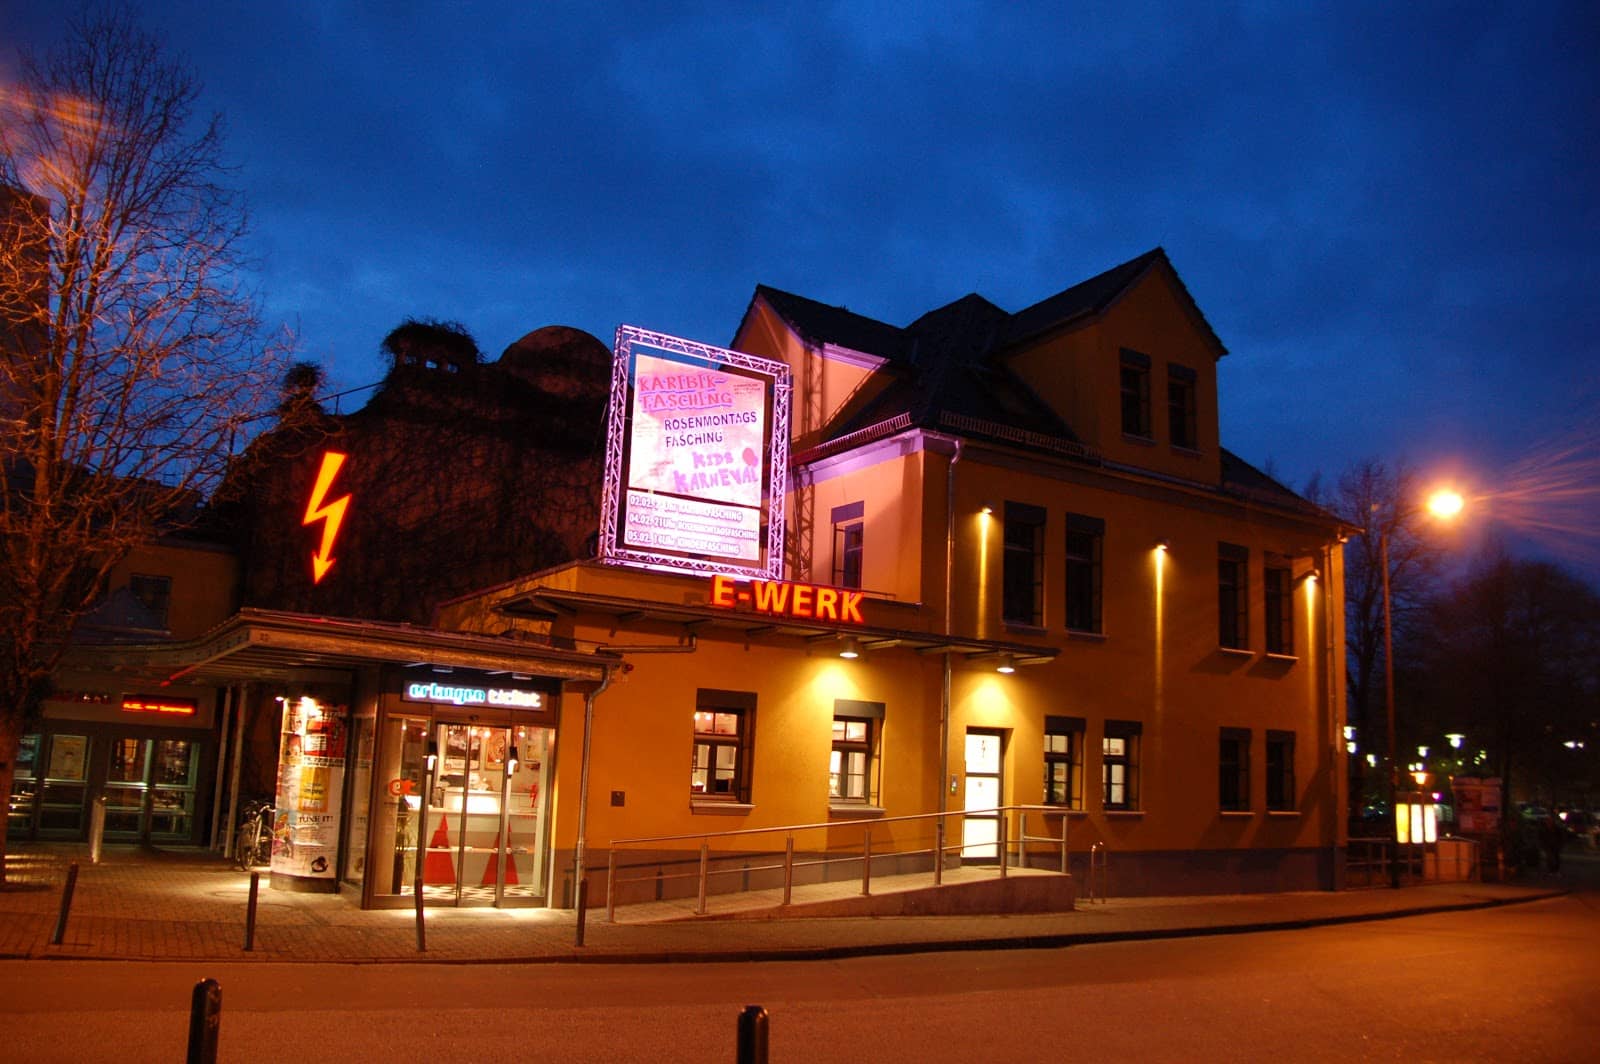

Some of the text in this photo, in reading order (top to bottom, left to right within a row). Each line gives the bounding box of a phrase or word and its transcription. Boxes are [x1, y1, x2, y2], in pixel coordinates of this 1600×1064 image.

[664, 411, 758, 431] ROSENMONTAGS
[665, 431, 723, 448] FASCHING
[692, 451, 734, 469] KIDS
[672, 467, 759, 493] KARNEVAL
[711, 574, 865, 624] E-WERK
[409, 683, 486, 705] erlangen
